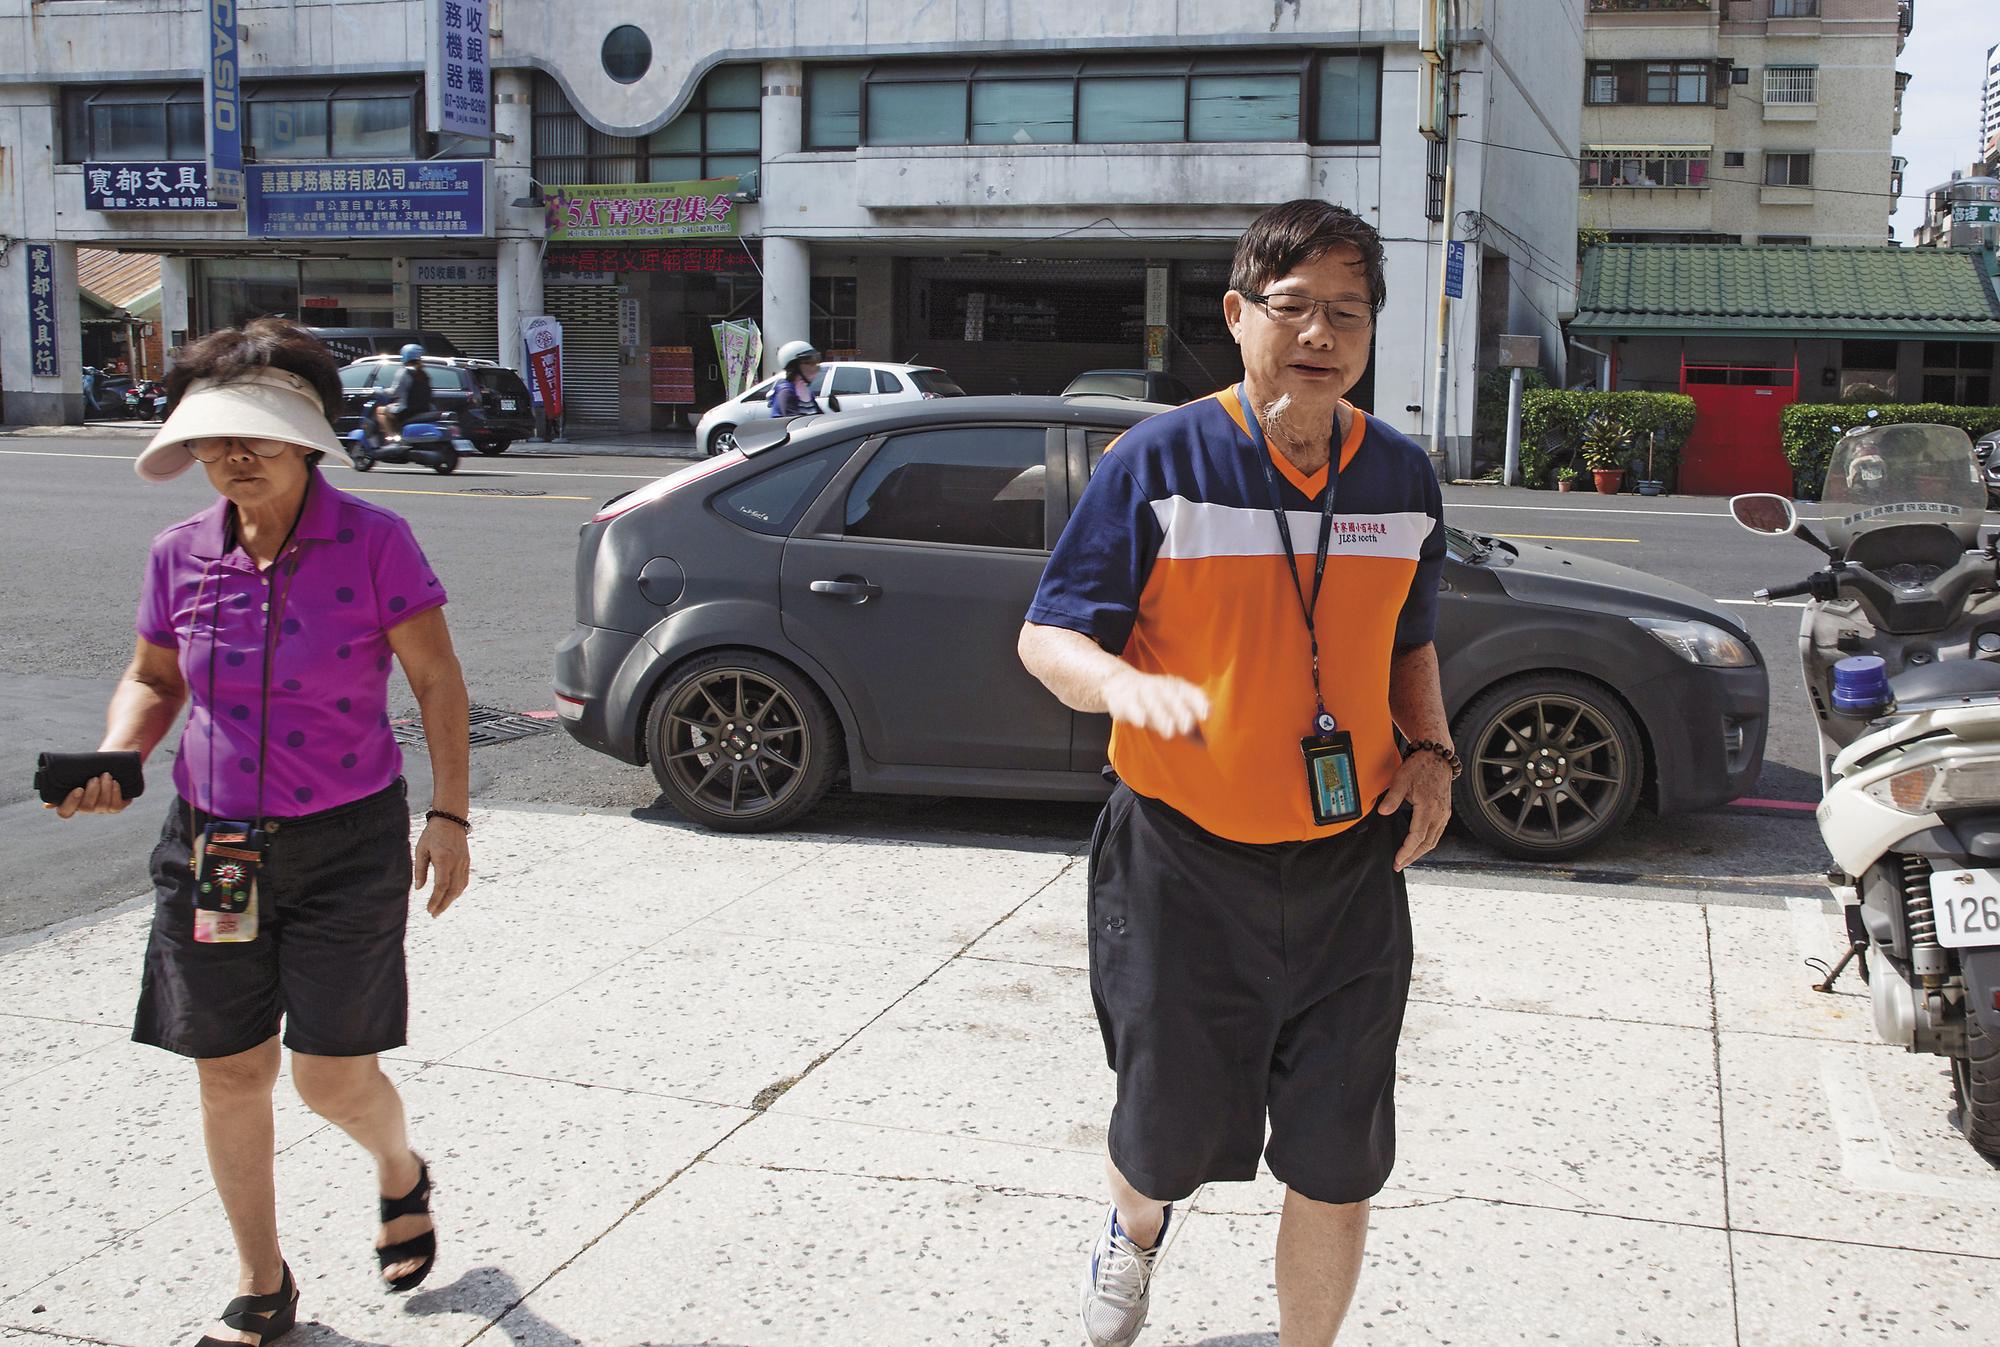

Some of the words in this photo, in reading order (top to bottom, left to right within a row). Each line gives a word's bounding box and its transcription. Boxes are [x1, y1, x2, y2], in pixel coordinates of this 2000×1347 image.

[466, 0, 484, 95] 收銀機
[213, 0, 236, 131] CASIO
[88, 167, 207, 196] 寬都文具
[261, 168, 406, 193] 嘉嘉事務機器有限公司
[1449, 243, 1456, 259] P
[1944, 896, 2000, 934] 126
